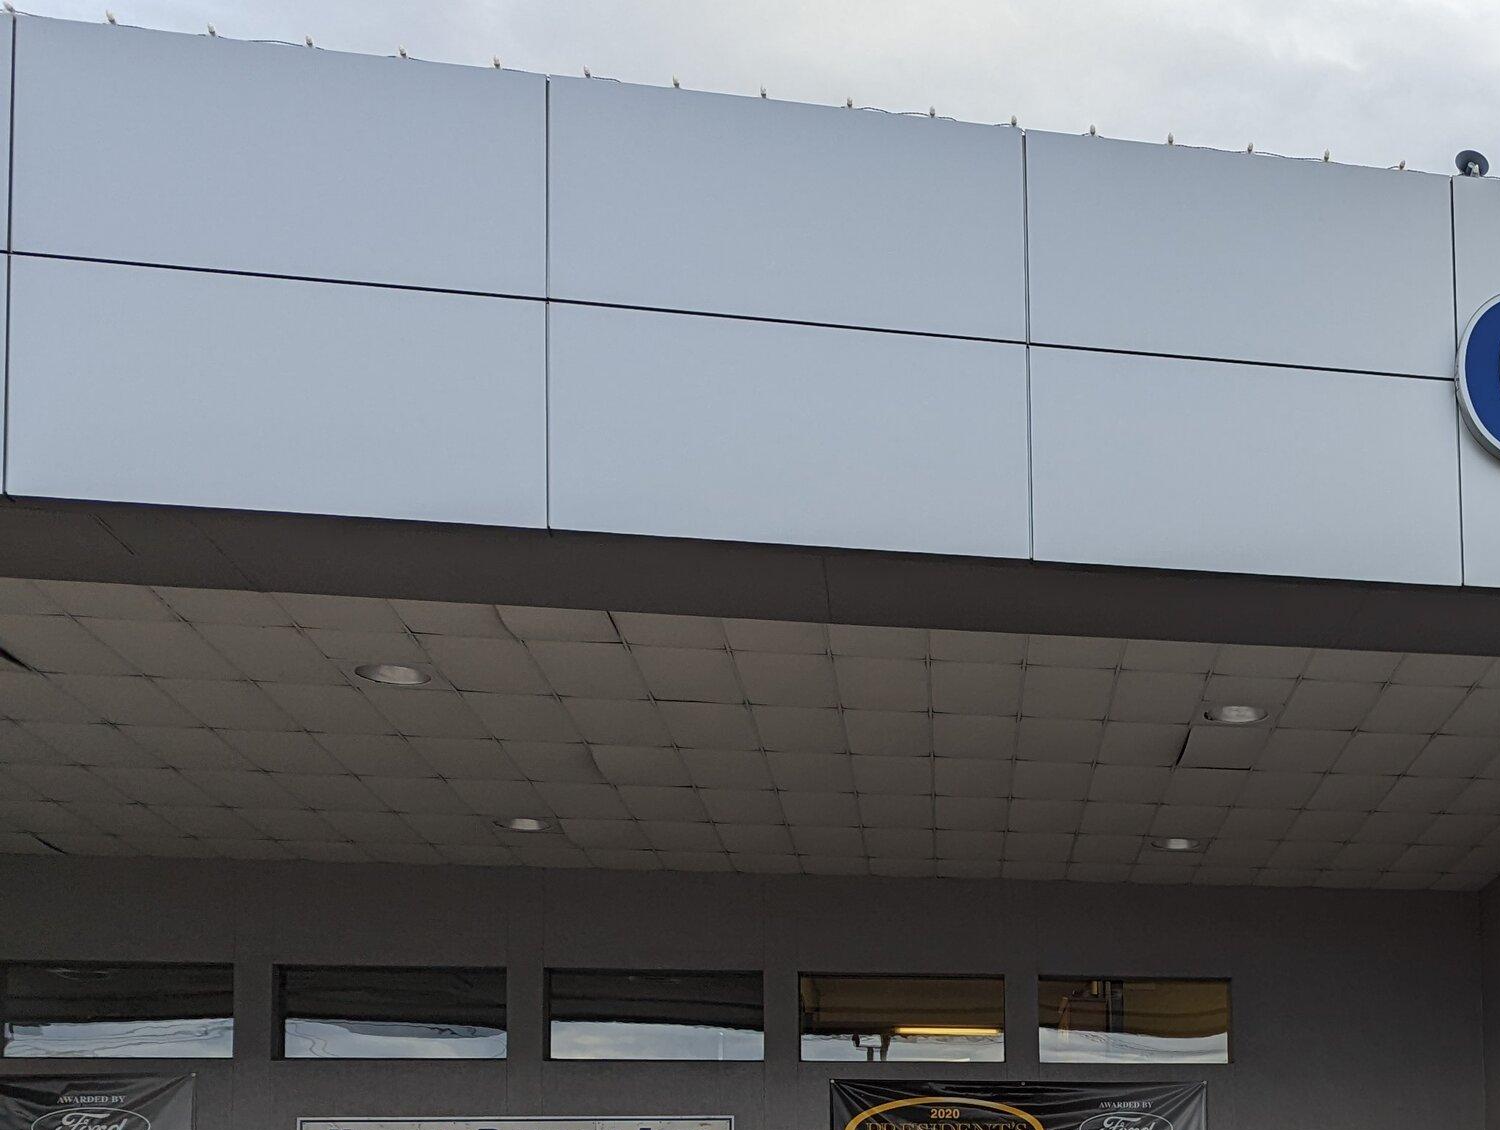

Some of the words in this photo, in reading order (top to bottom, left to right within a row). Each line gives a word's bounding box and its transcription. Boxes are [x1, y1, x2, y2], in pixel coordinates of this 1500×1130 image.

[57, 1096, 108, 1104] AWARDED
[1099, 1101, 1140, 1109] AWARDED
[930, 1109, 960, 1119] 2020
